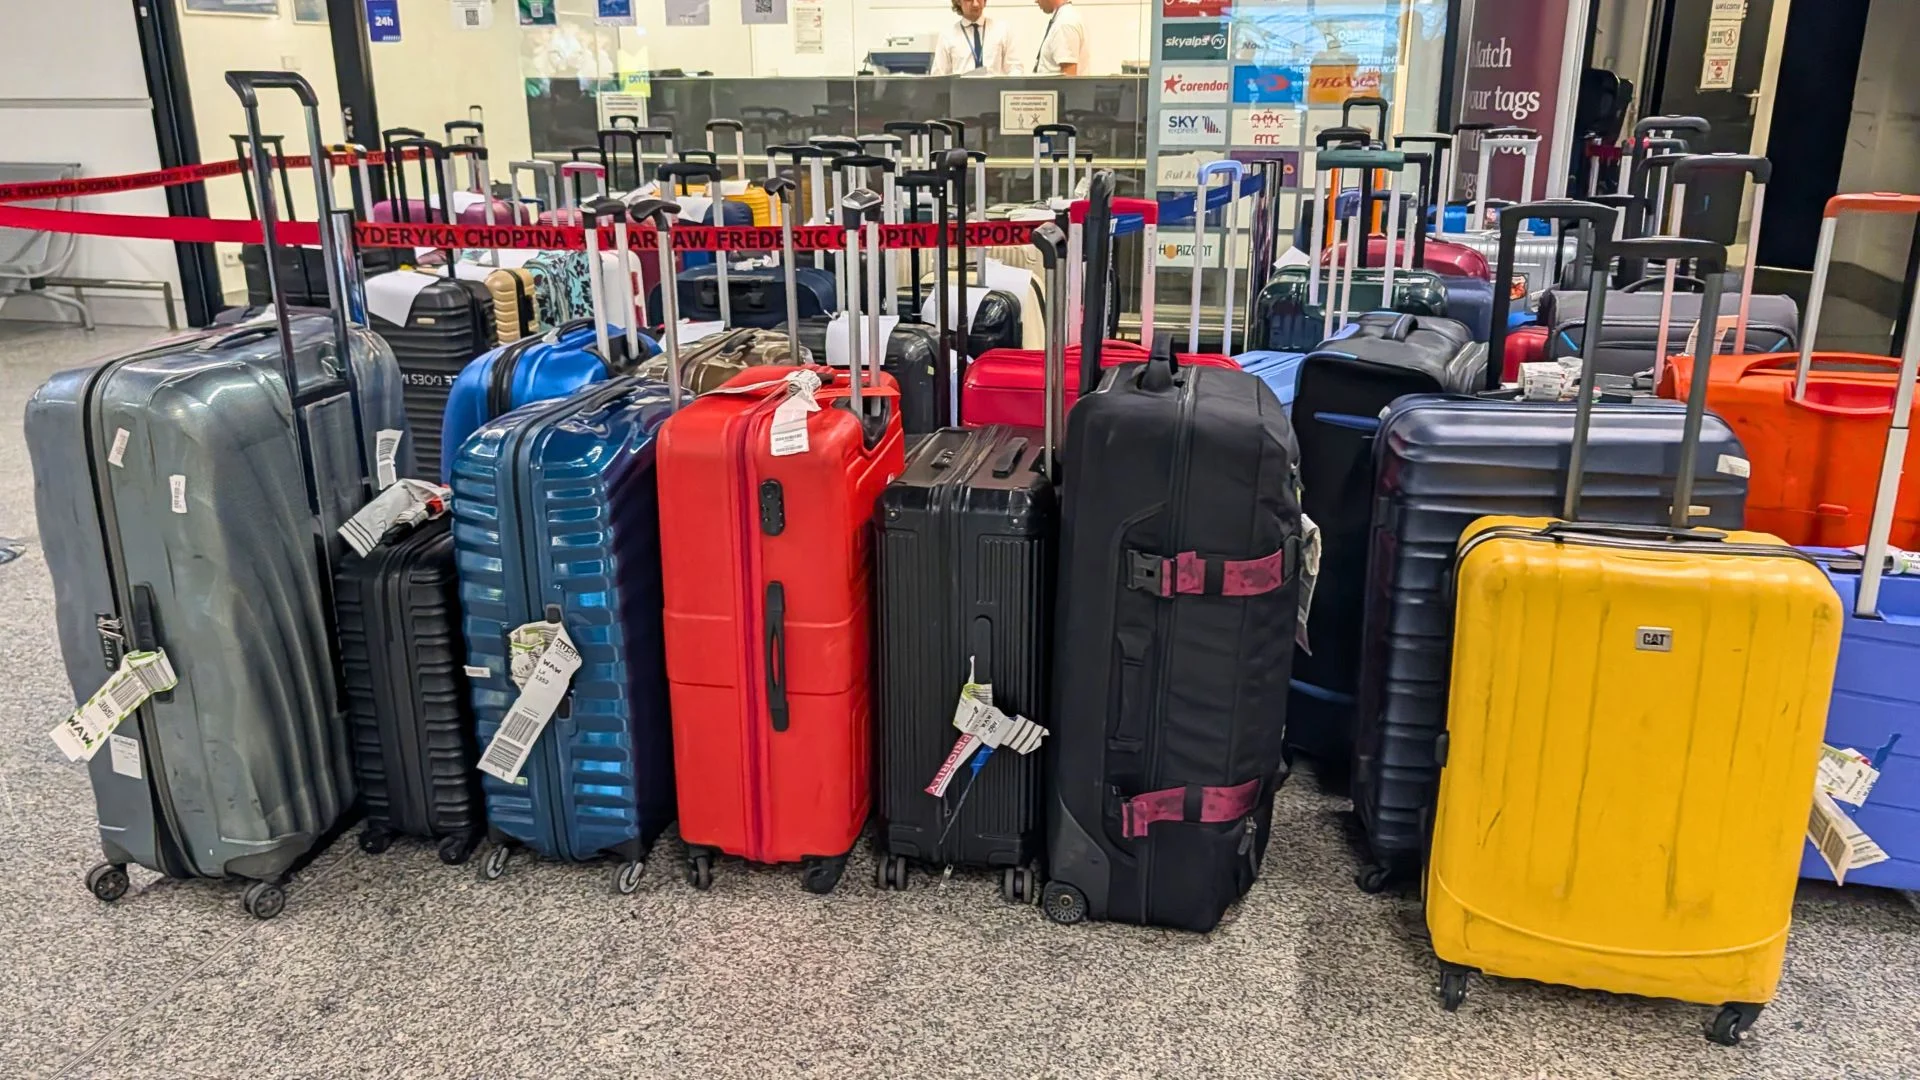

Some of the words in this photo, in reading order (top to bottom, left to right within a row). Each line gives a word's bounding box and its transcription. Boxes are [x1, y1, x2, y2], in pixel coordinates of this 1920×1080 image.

[375, 16, 394, 27] 24h
[1165, 35, 1210, 48] skyalps
[1180, 79, 1229, 92] corendon
[1494, 85, 1540, 120] tags
[1168, 115, 1199, 128] SKY
[353, 226, 458, 247] YDERYKA
[464, 229, 567, 249] CHOPINA
[604, 229, 709, 249] WARAW
[716, 229, 831, 249] FREDERIC
[1642, 632, 1666, 646] CAT
[543, 658, 562, 674] WAW
[66, 714, 95, 745] WAW
[930, 734, 974, 794] PRIORITY
